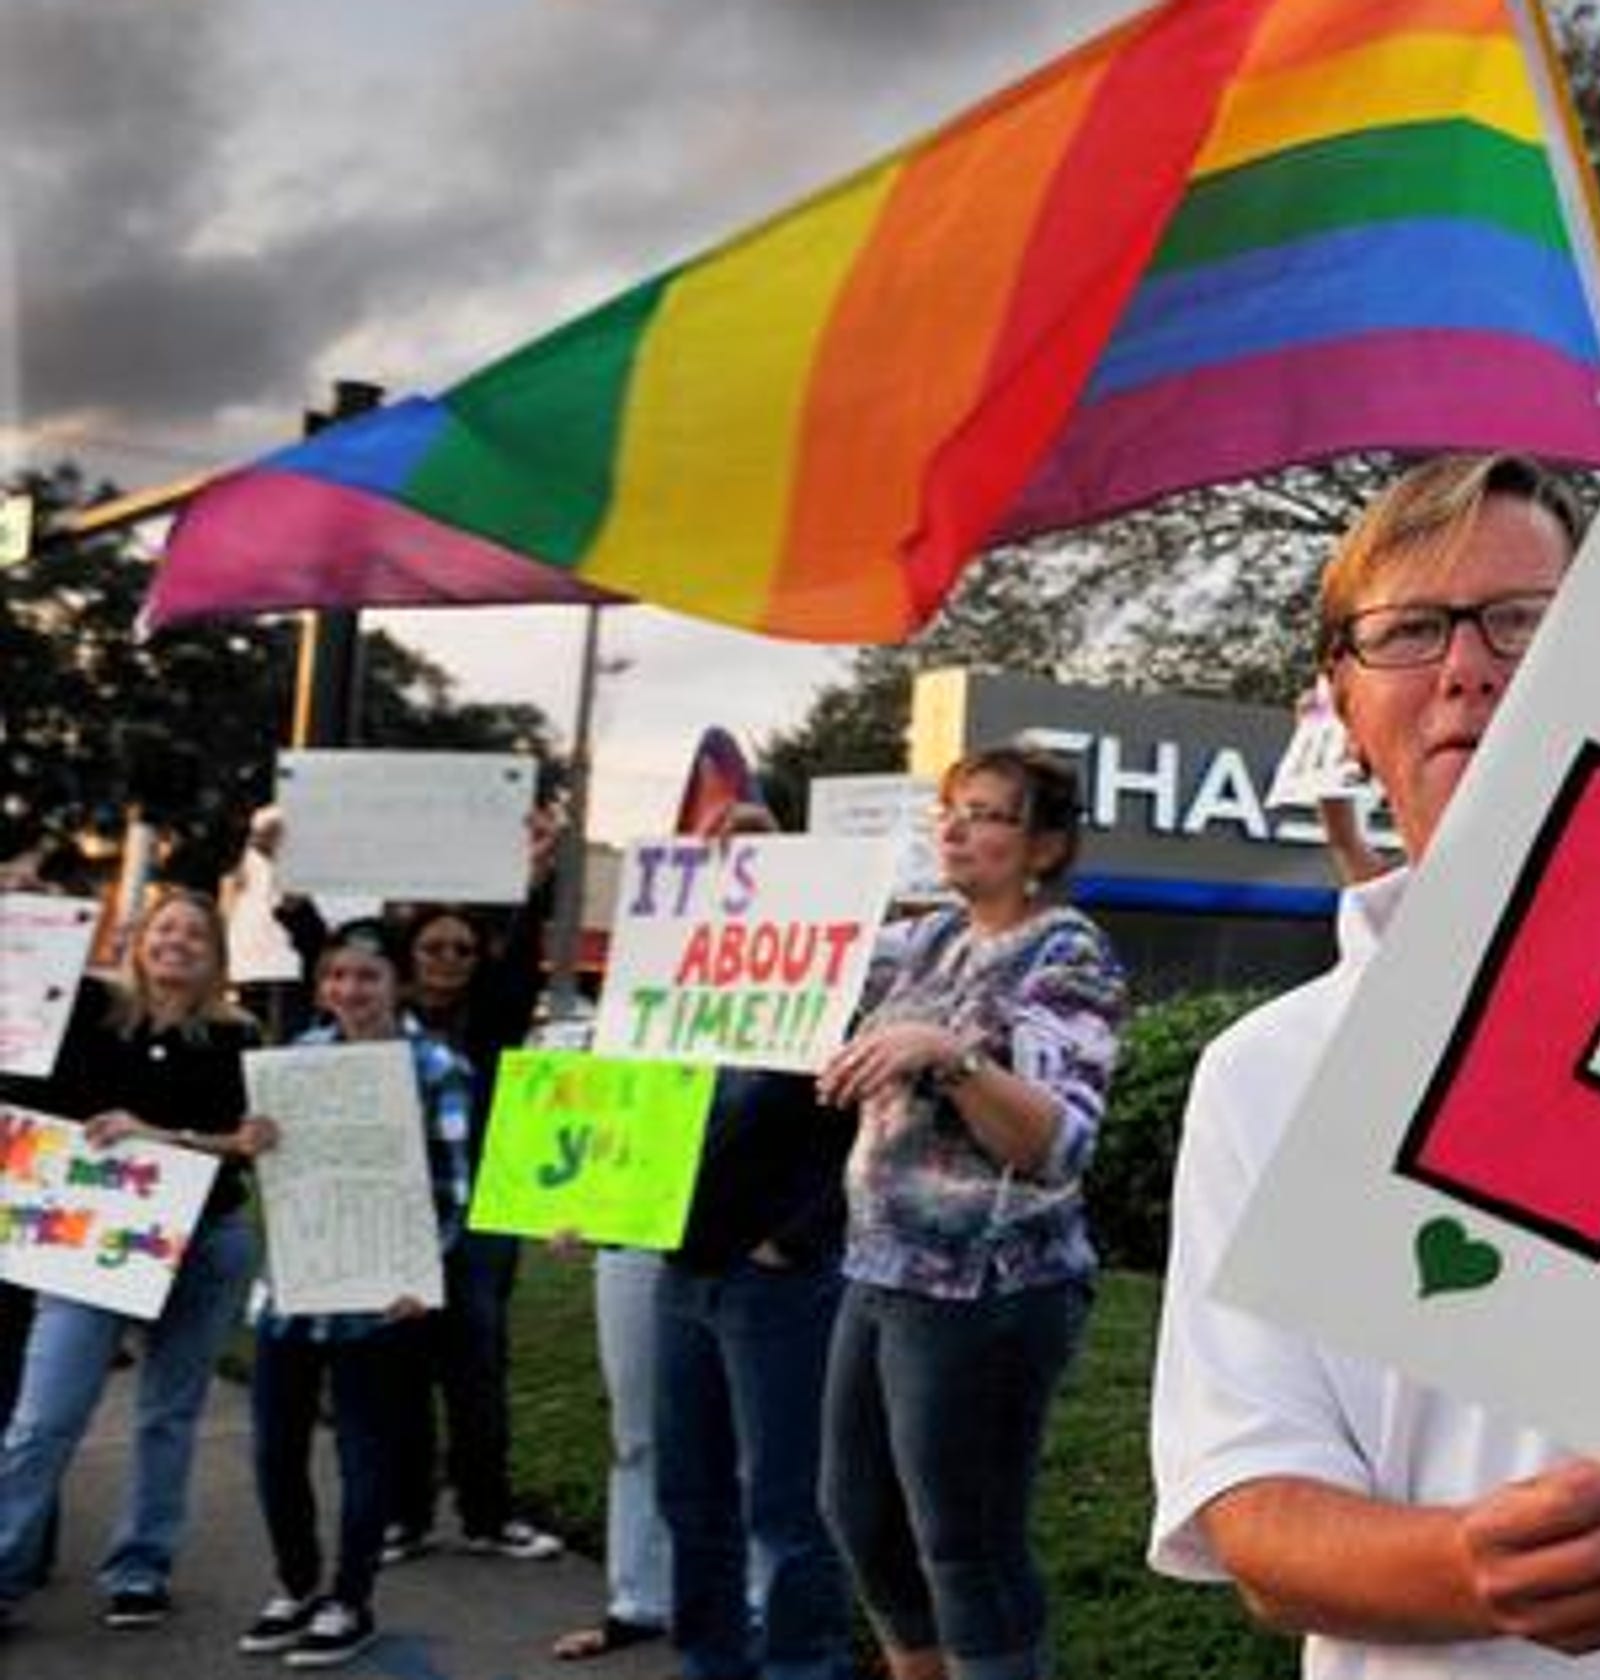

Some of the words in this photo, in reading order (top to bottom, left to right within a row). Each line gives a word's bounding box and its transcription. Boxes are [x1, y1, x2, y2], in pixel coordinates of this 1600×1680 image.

[630, 837, 757, 916] IT'S
[675, 921, 860, 986] ABOUT
[631, 986, 829, 1049] TIME!!!
